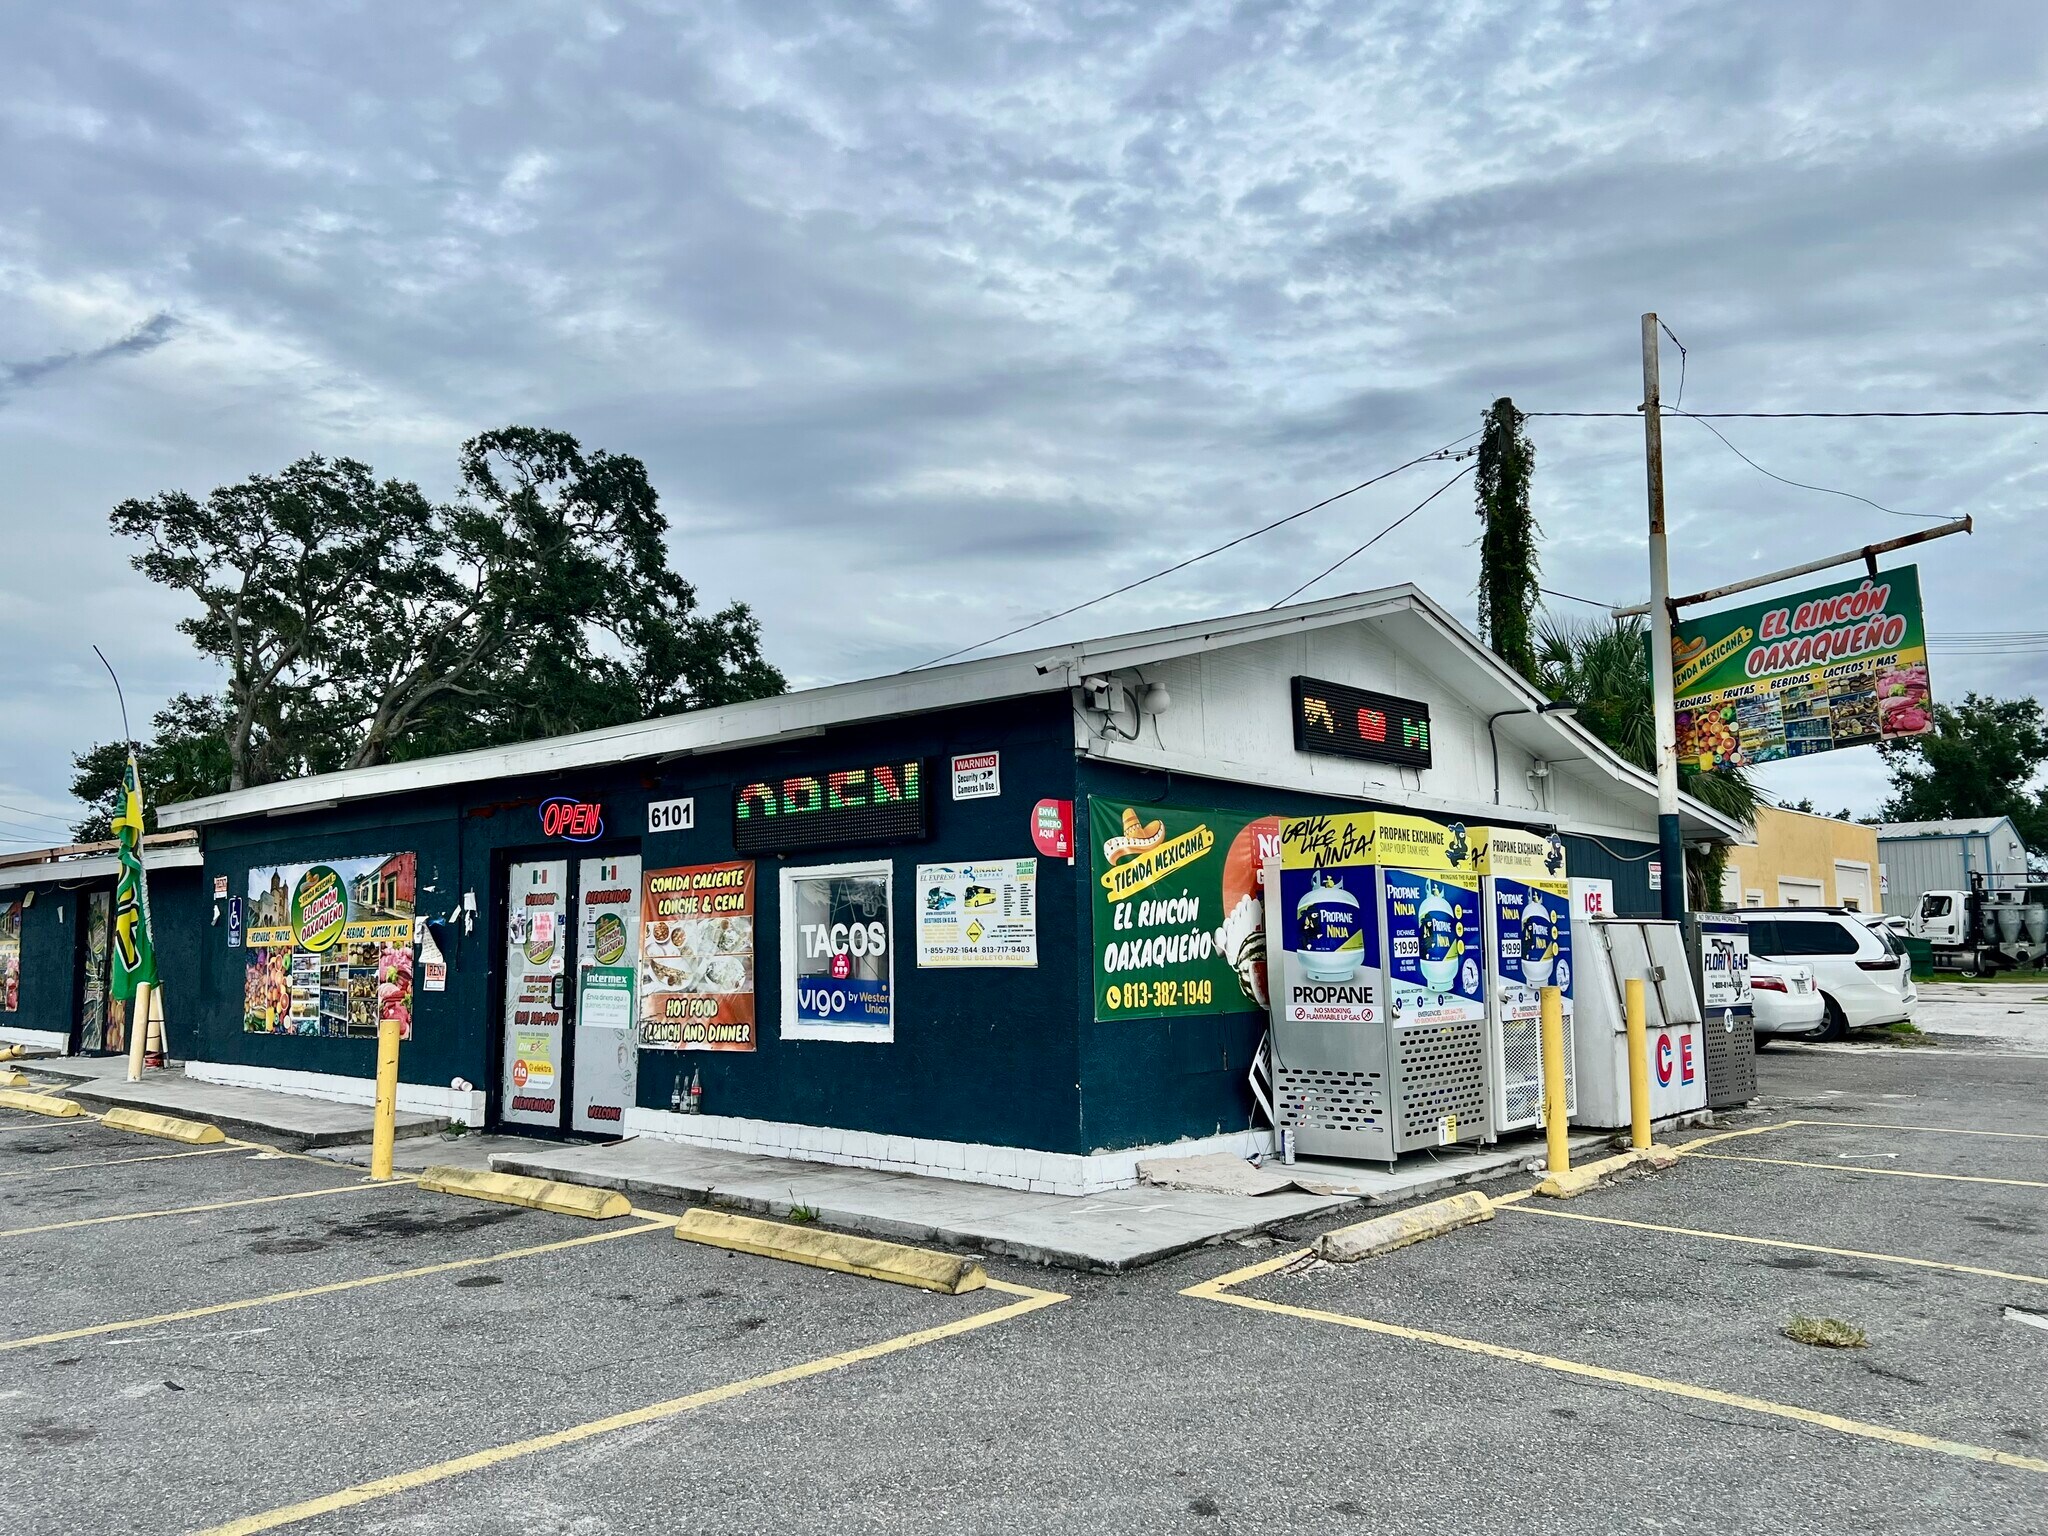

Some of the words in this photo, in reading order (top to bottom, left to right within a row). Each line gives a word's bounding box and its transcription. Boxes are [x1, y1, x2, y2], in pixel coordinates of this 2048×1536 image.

[1761, 610, 1788, 639] EL
[1794, 582, 1888, 631] RINCÓN
[1747, 616, 1904, 675] OAXAQUEÑO
[1674, 663, 1698, 689] IENDA
[1699, 632, 1744, 671] MEXICANA
[1723, 684, 1755, 700] FRUTAS
[1770, 673, 1811, 690] BEBIDAS
[1823, 660, 1864, 679] LACTEOS
[1866, 659, 1874, 670] Y
[1876, 654, 1898, 668] MAS
[956, 757, 995, 770] WARNING
[957, 773, 979, 783] Security
[957, 785, 978, 794] Cameras
[979, 783, 984, 791] In
[985, 782, 995, 790] Use
[543, 803, 601, 836] OPEN
[651, 803, 691, 828] 6101
[1038, 806, 1057, 818] ENVÍA
[1038, 819, 1062, 829] DINERO
[1282, 816, 1332, 844] GRILL
[1038, 828, 1055, 839] AQUÍ
[1300, 829, 1337, 855] LIKE
[1342, 822, 1357, 840] A
[1380, 826, 1411, 842] PROPANE
[1412, 829, 1445, 846] EXCHANGE
[1313, 830, 1376, 868] NINJA!
[1380, 842, 1393, 853] SWAP
[1394, 843, 1406, 854] YOUR
[1406, 845, 1418, 855] TANK
[1419, 846, 1430, 856] HERE
[1493, 840, 1517, 854] PROPANE
[1517, 841, 1544, 856] EXCHANGE
[1115, 858, 1152, 892] TIENDA
[1155, 832, 1204, 872] MEXICANA
[650, 874, 690, 893] COMIDA
[692, 869, 745, 890] CALIENTE
[928, 873, 956, 881] EXPRESO
[585, 888, 632, 905] BIENVENIDOS
[1387, 884, 1420, 899] PROPANE
[1497, 891, 1523, 905] PROPANE
[303, 905, 312, 922] EL
[312, 886, 338, 918] RINCÓN
[525, 893, 555, 906] WELCOME
[658, 896, 699, 916] LONCHE
[701, 895, 712, 913] &
[714, 893, 745, 912] CENA
[1584, 893, 1602, 912] ICE
[1114, 902, 1133, 931] EL
[1138, 888, 1200, 928] RINCÓN
[1320, 909, 1353, 923] PROPANE
[1394, 901, 1416, 916] NINJA
[1502, 907, 1520, 920] NINJA
[301, 903, 344, 942] OAXAQUEÑO
[1432, 918, 1452, 933] PROPANE
[1705, 914, 1721, 922] SMOKING
[275, 930, 291, 941] FRUTAS
[346, 926, 366, 939] BEBIDAS
[370, 925, 391, 938] LACTEOS
[398, 924, 409, 936] MAS
[1326, 924, 1349, 938] NINJA
[1396, 929, 1416, 937] EXCHANGE
[1532, 922, 1549, 936] PROPANE
[800, 921, 886, 958] TACOS
[1436, 934, 1450, 947] NINJA
[924, 946, 978, 954] 1-855-792-1644
[981, 945, 1030, 953] 813-717-9403
[1104, 927, 1212, 973] OAXAQUEÑO
[1394, 940, 1419, 955] $19.99
[1502, 943, 1521, 955] $19.99
[586, 972, 628, 984] intermex
[848, 991, 858, 1004] by
[1123, 979, 1212, 1009] 813-382-1949
[1293, 986, 1374, 1004] PROPANE
[666, 999, 688, 1018] HOT
[689, 999, 718, 1017] FOOD
[865, 1003, 889, 1015] Union
[646, 1023, 681, 1042] LUNCH
[683, 1023, 706, 1042] AND
[707, 1023, 751, 1042] DINNER
[514, 1063, 527, 1077] ria
[534, 1063, 552, 1073] elektra
[512, 1096, 555, 1113] BIENVENIDOS
[587, 1104, 622, 1121] WELCOME
